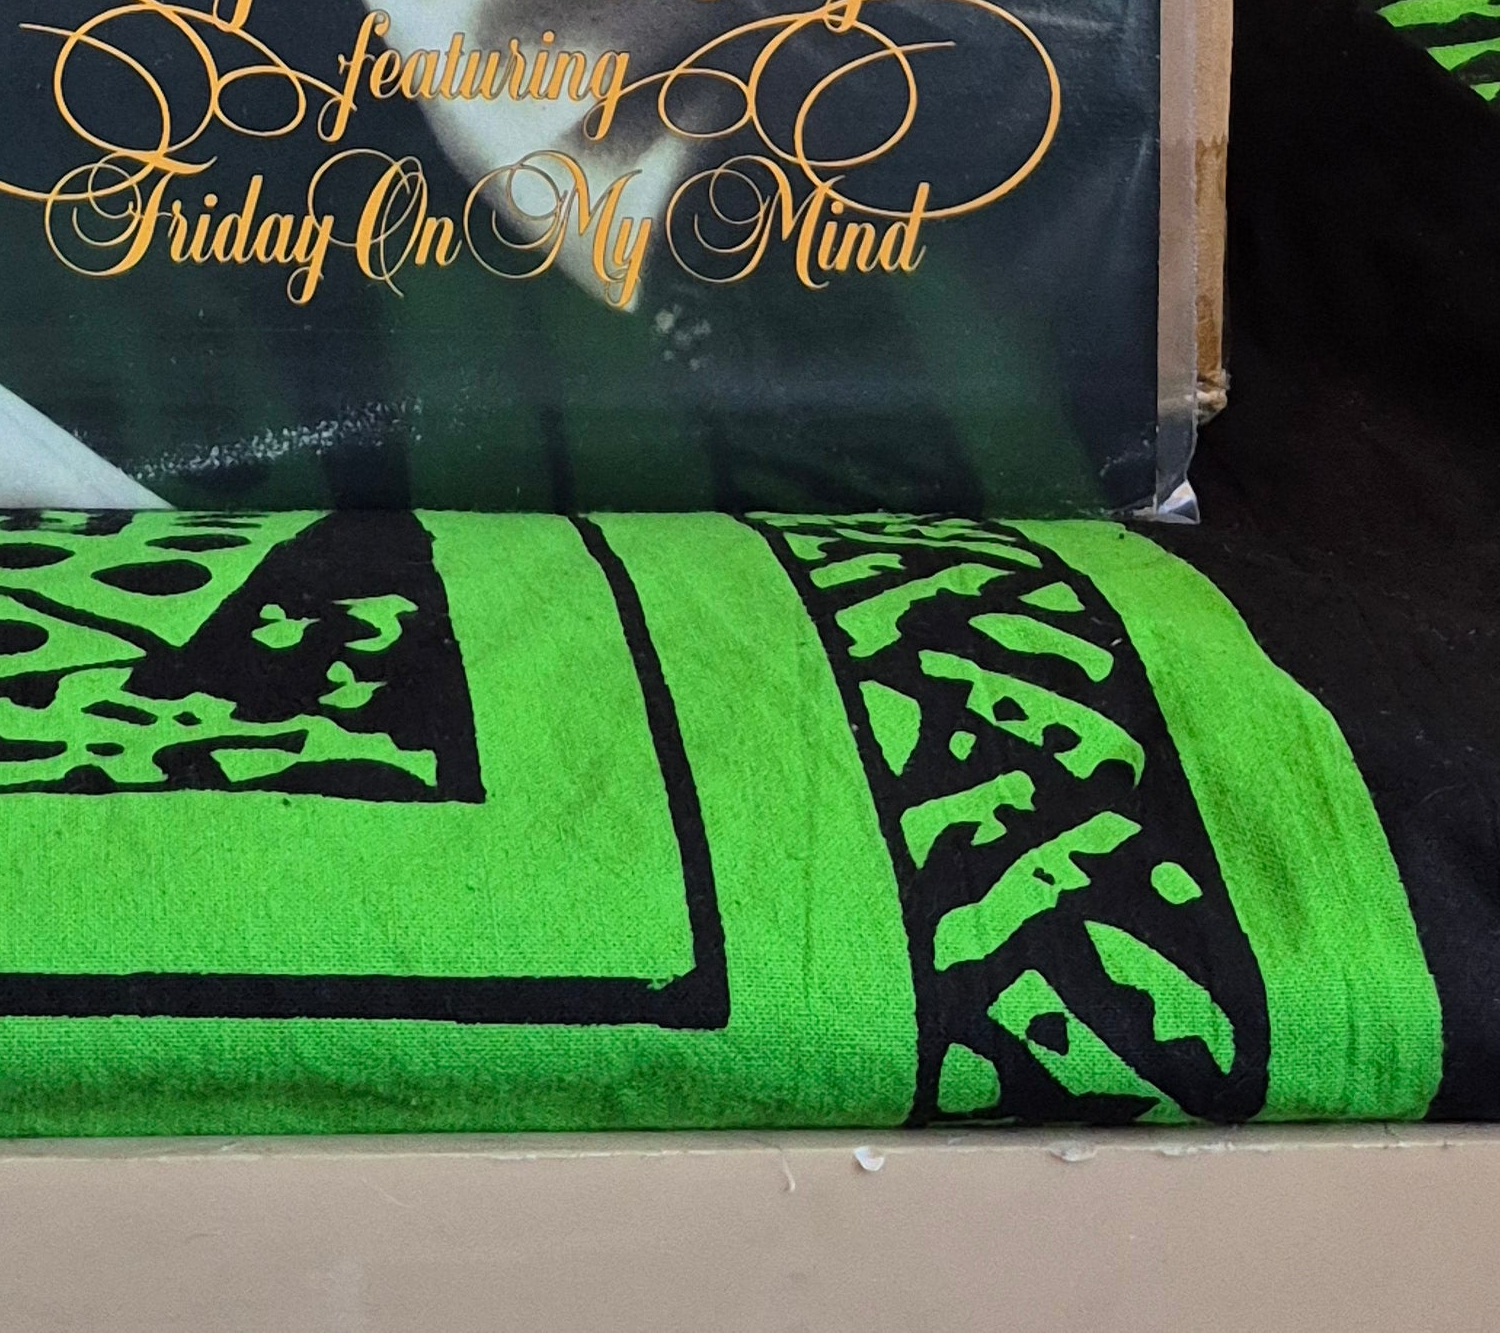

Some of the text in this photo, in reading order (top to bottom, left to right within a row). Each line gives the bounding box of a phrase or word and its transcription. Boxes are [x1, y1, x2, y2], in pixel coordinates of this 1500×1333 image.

[326, 10, 632, 141] featuring
[45, 149, 928, 309] Friday On My Mind
